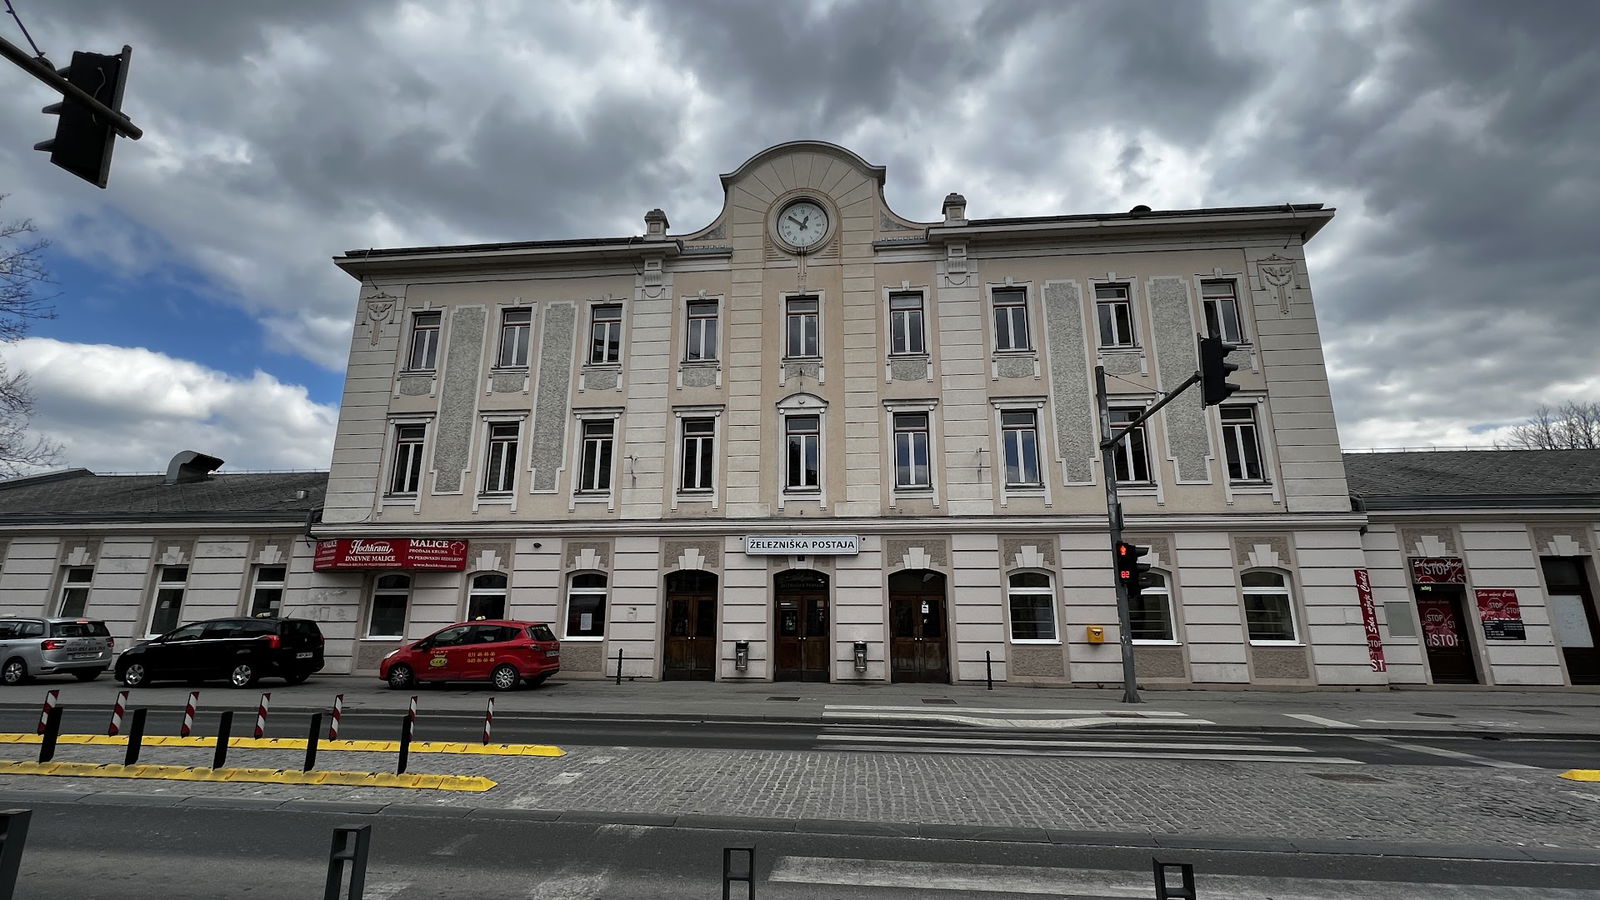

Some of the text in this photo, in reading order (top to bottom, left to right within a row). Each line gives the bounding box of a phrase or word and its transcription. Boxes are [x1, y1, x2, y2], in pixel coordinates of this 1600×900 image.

[409, 539, 449, 548] MALICE
[750, 539, 855, 549] ŽELEZNIŠKA POSTAJA
[1424, 564, 1449, 575] STOP
[1426, 614, 1444, 622] STOP
